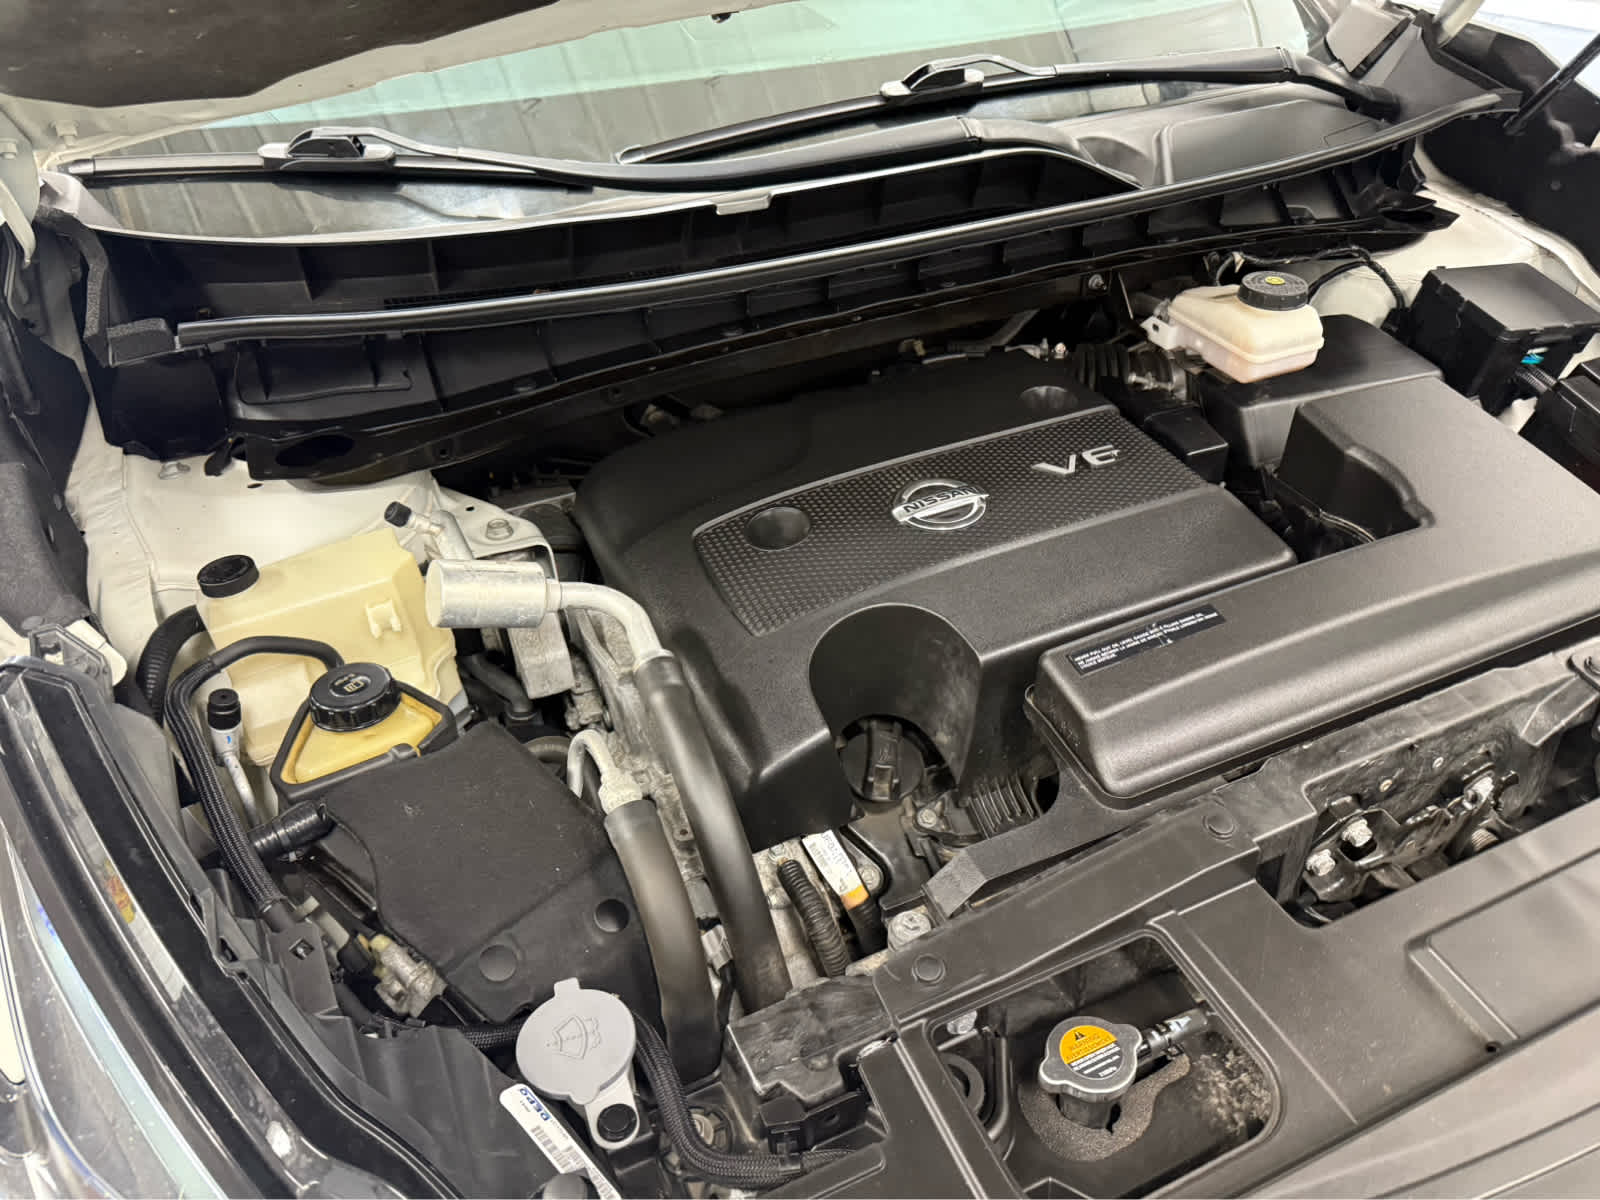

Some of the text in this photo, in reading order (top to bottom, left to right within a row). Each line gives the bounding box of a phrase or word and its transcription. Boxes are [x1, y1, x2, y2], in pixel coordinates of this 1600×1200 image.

[1031, 444, 1120, 475] V6
[903, 486, 978, 512] NISSAN
[519, 1087, 551, 1121] DEPO
